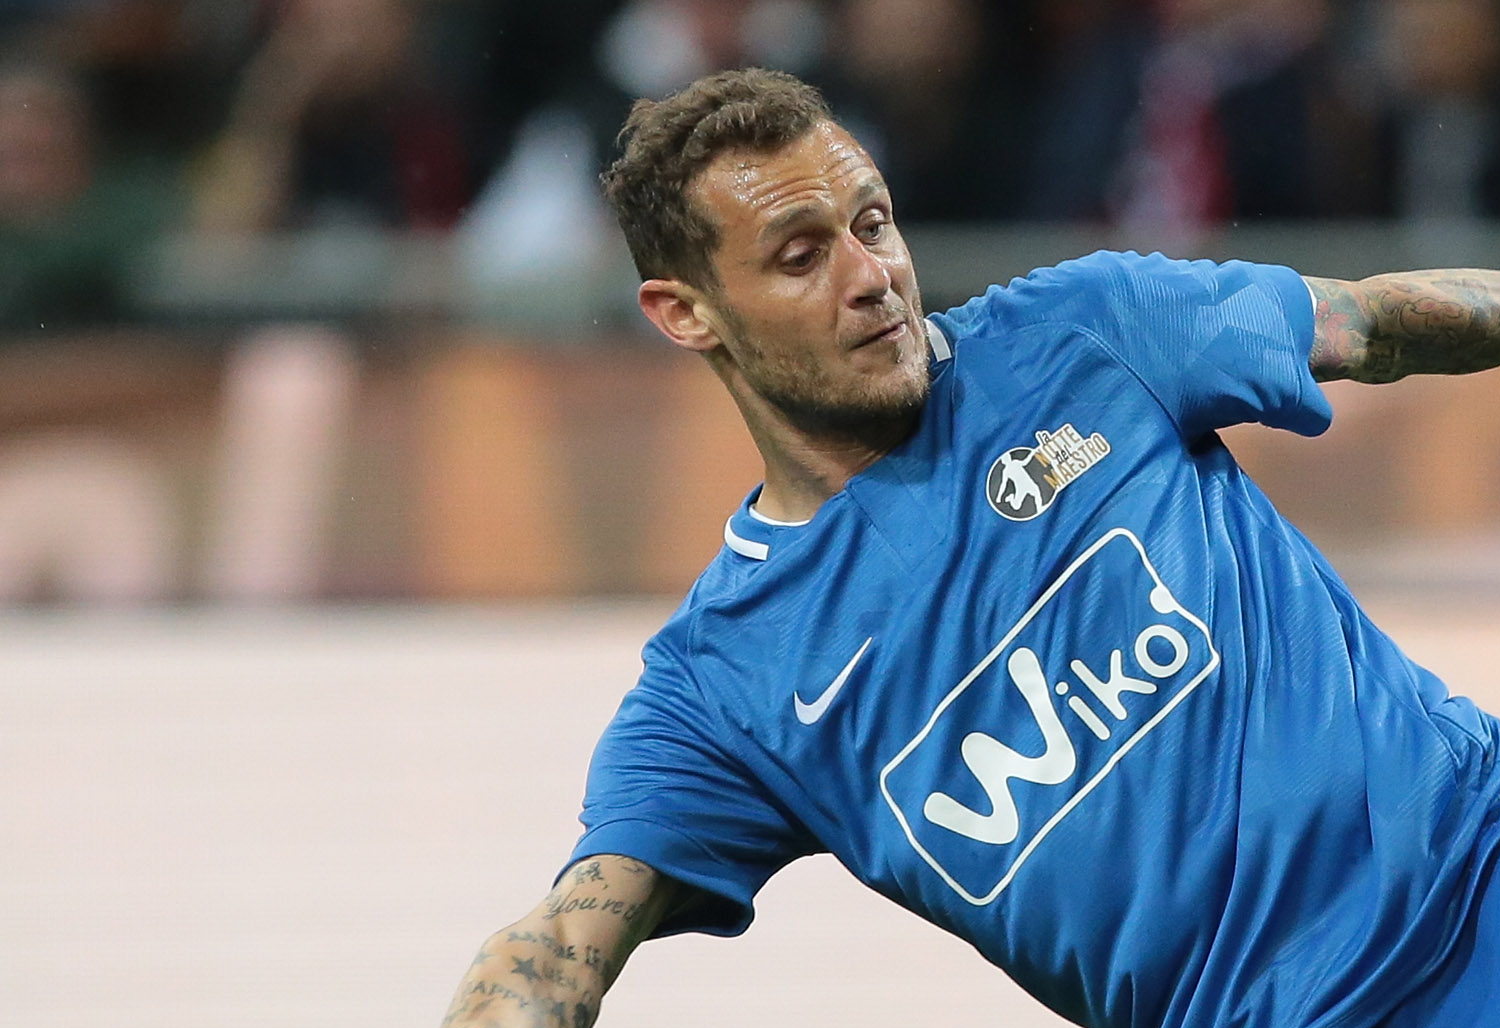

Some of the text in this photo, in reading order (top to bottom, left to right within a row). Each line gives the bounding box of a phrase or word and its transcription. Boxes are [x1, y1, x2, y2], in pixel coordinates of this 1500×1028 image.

[1034, 425, 1081, 468] NOTTE
[1042, 434, 1108, 489] MAESTRO
[923, 623, 1189, 845] Wiko
